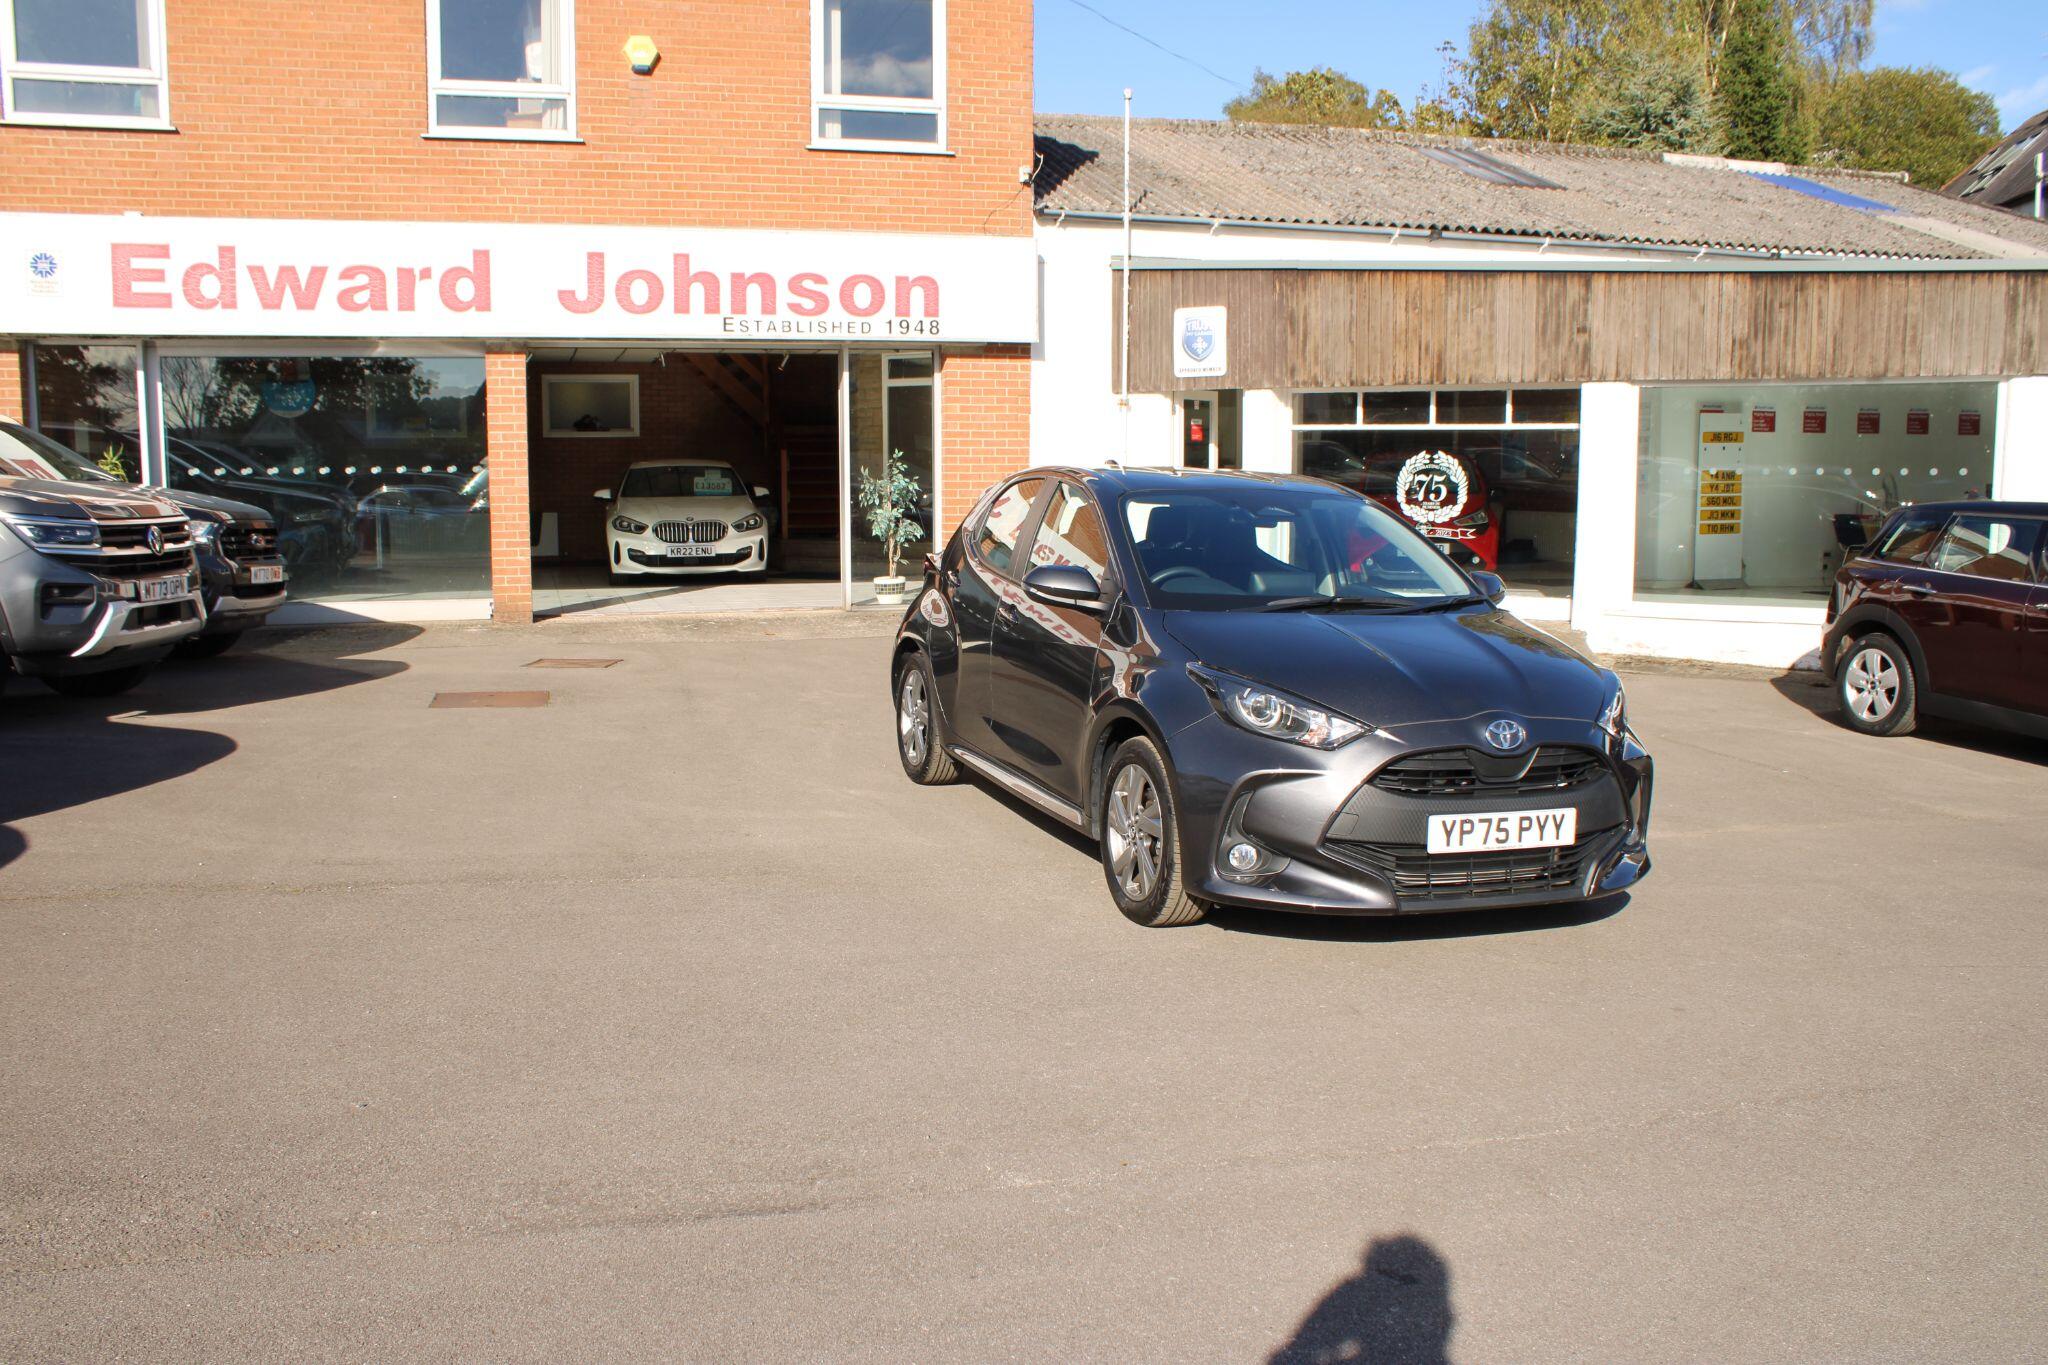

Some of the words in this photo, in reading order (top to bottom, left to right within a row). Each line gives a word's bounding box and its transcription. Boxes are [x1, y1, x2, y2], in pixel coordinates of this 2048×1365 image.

[110, 242, 492, 313] Edward
[557, 251, 940, 318] Johnson
[722, 316, 873, 334] ESTABLISHED
[885, 319, 940, 335] 1948
[1413, 473, 1447, 502] 75
[670, 547, 693, 556] KR22
[695, 547, 713, 555] ENU
[144, 579, 168, 599] MT73
[1441, 817, 1510, 848] YP75
[1517, 813, 1566, 844] PYY
